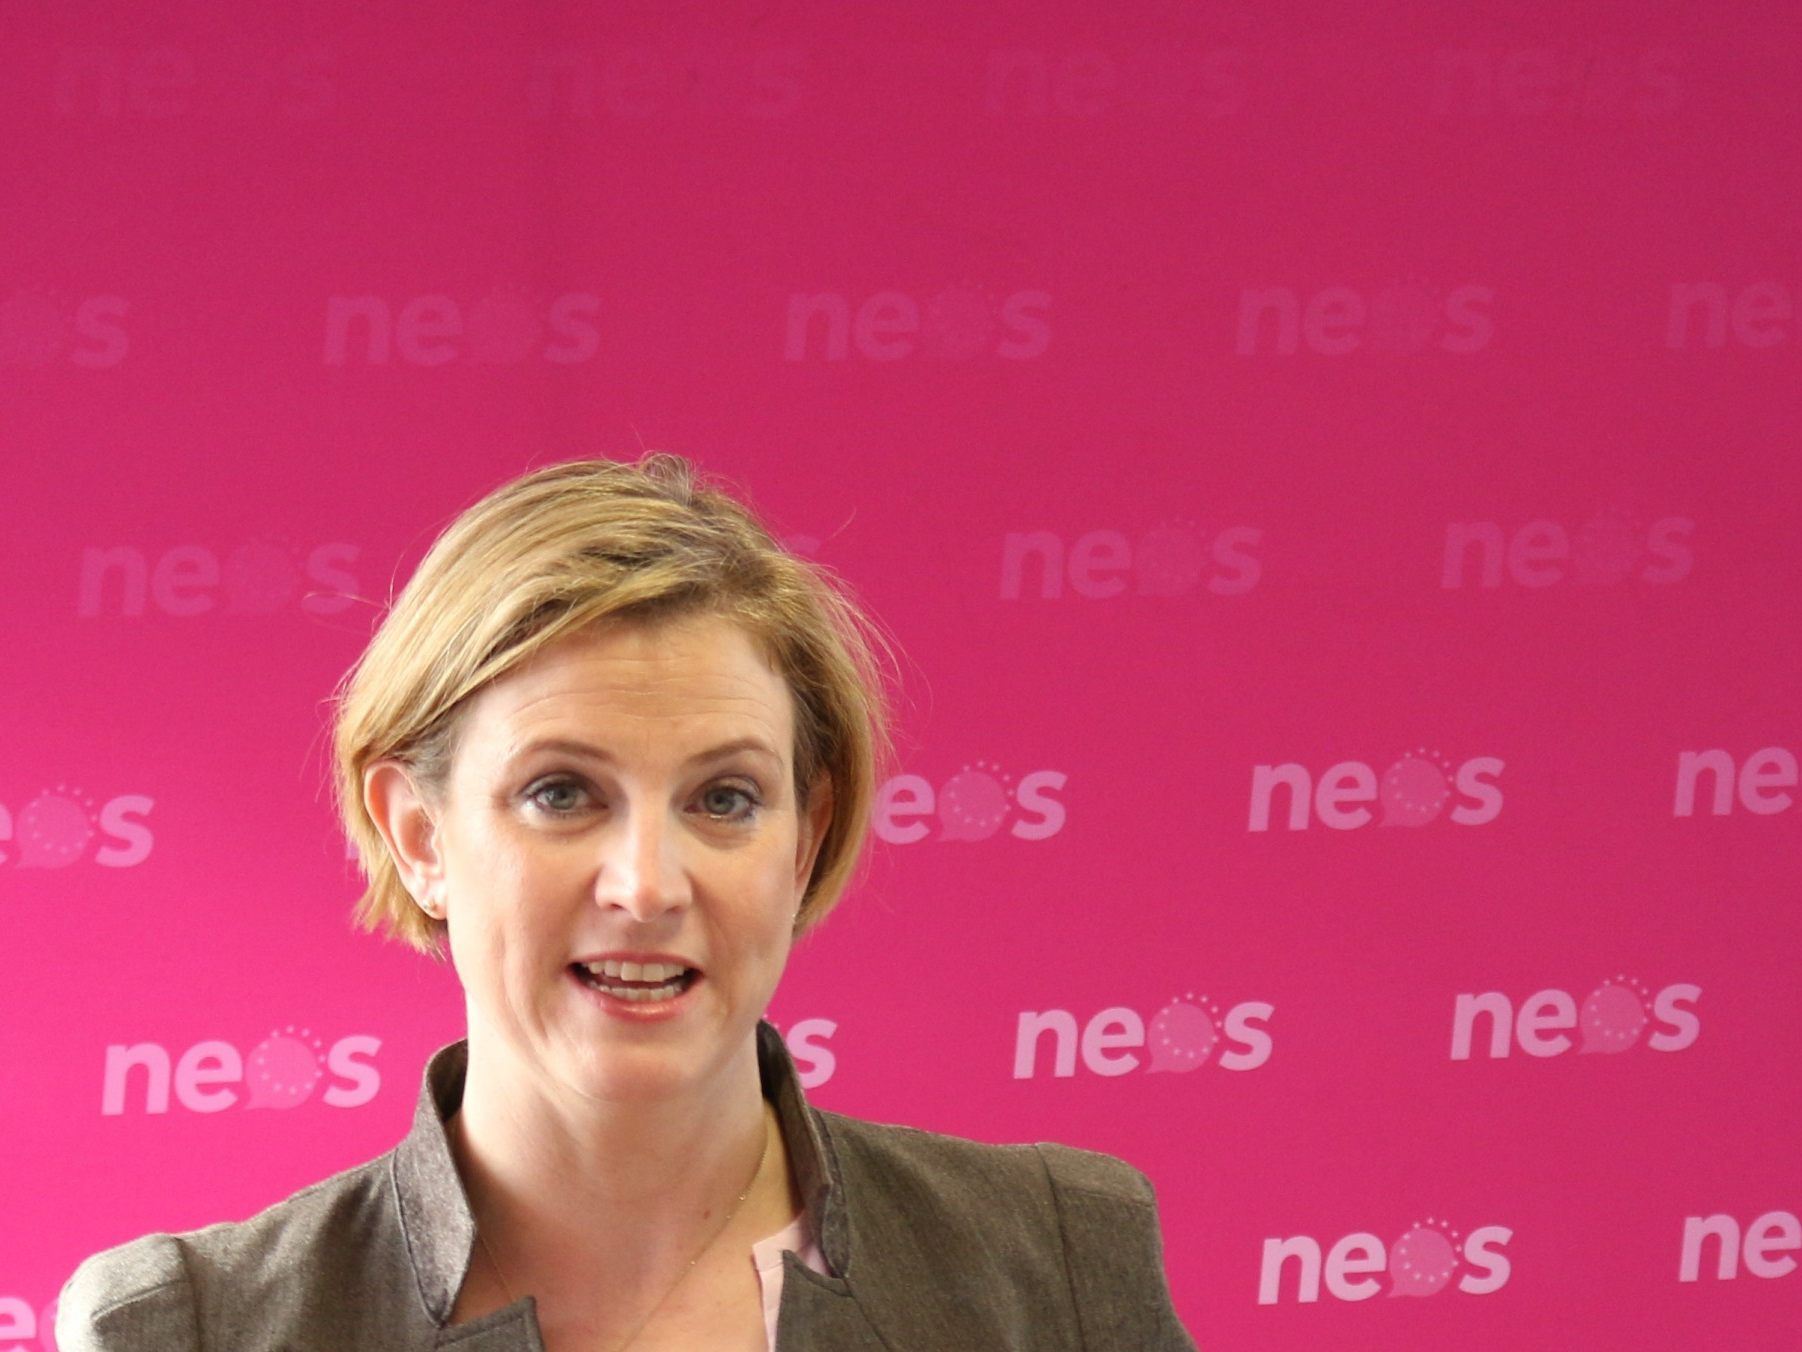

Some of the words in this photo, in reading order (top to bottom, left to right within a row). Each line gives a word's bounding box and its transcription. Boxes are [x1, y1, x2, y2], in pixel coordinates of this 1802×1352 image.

[0, 288, 130, 366] os
[324, 293, 600, 366] neos
[784, 290, 1052, 361] neos
[1237, 285, 1493, 356] neos
[78, 543, 365, 618] neos
[999, 526, 1261, 599] neos
[1441, 516, 1693, 589] neos
[0, 790, 154, 869] os
[871, 764, 1068, 844] eos
[1248, 757, 1503, 832] neos
[1013, 1001, 1273, 1079] neos
[1450, 984, 1700, 1059] neos
[103, 1035, 380, 1115] neos
[1258, 1226, 1511, 1304] neos
